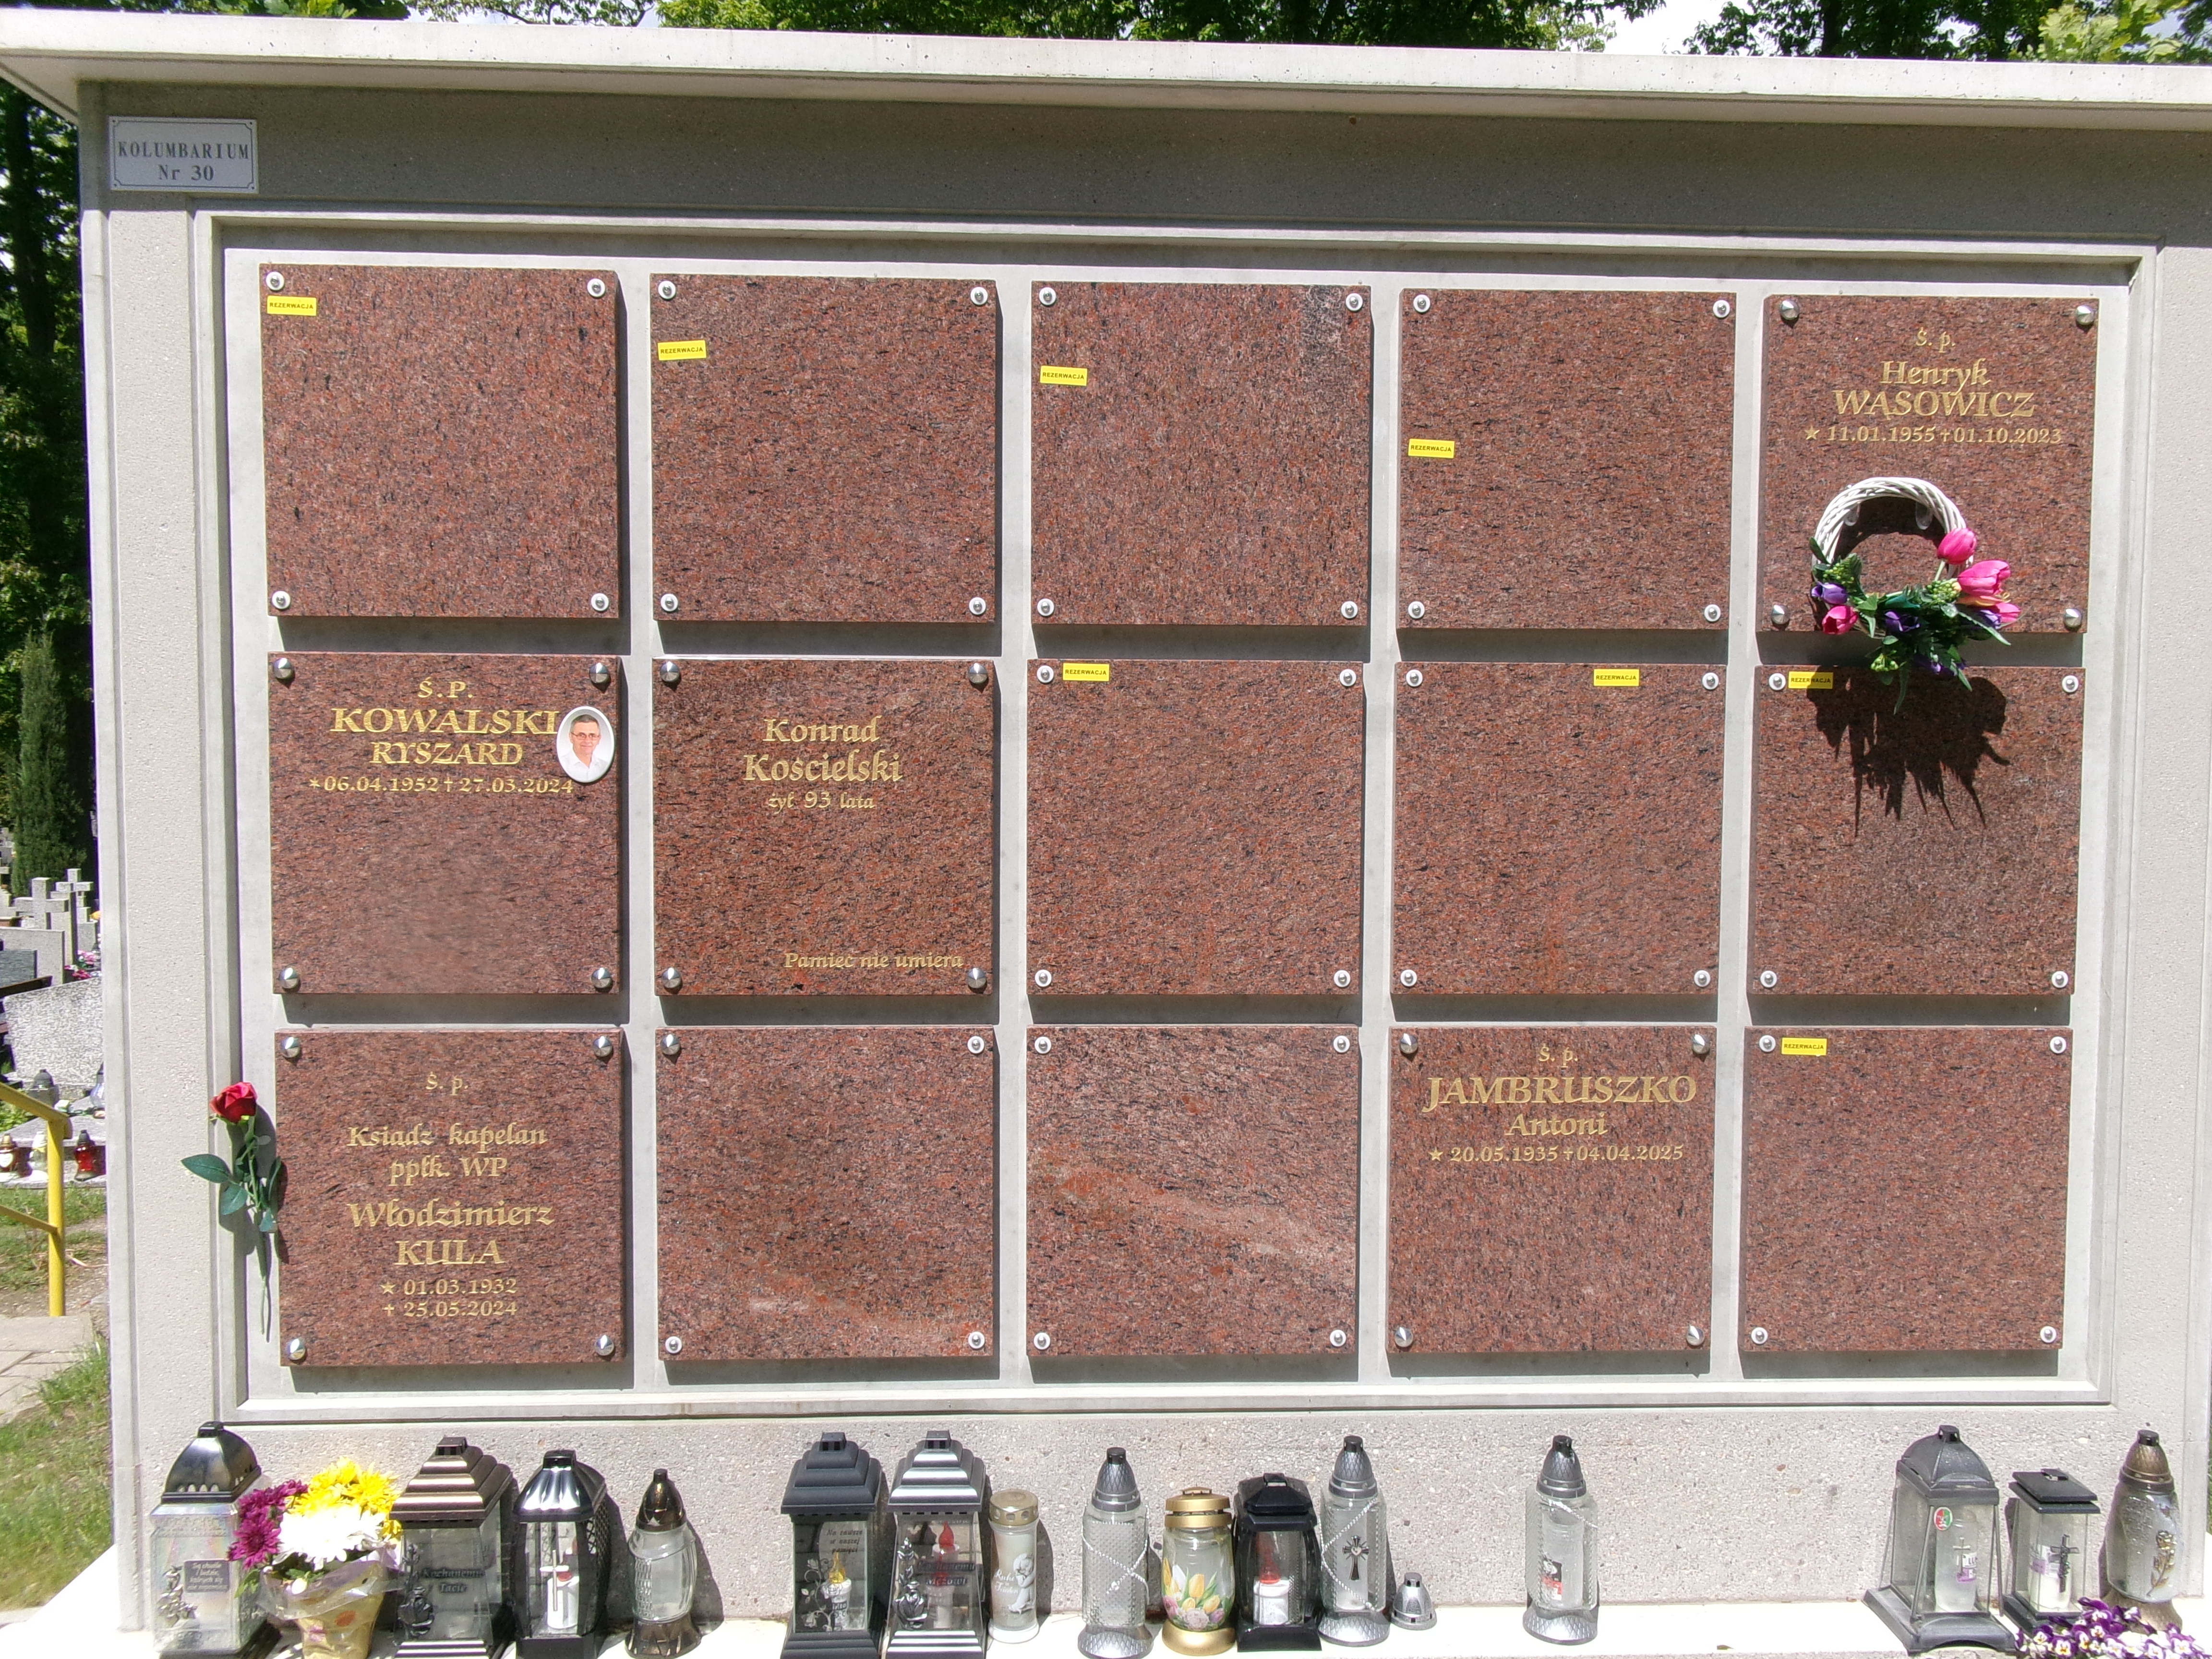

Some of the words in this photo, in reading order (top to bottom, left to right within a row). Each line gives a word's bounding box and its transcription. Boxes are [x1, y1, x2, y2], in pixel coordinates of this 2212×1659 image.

[118, 141, 249, 159] KOLUMBARIUM
[158, 165, 180, 180] Nr
[191, 165, 214, 180] 30
[1879, 358, 1991, 397] Henryk
[1832, 389, 2037, 421] WĄSOWICZ
[1827, 425, 1936, 443] 11.01.1955
[1953, 427, 2062, 444] 01.10.2023
[330, 708, 560, 735] KOWALSKI
[762, 715, 882, 743] Konrad
[369, 741, 524, 765] RYSZARD
[743, 749, 903, 781] Kościelski
[324, 775, 442, 793] 06.04.1952
[458, 777, 574, 794] 27.03.2024
[804, 791, 831, 808] 93
[841, 792, 876, 808] lata
[784, 952, 855, 969] Pamięć
[859, 952, 890, 967] nie
[895, 951, 964, 968] umiera
[1421, 1075, 1697, 1113] JAMBRUSZKO
[1504, 1111, 1609, 1136] Antoni
[347, 1123, 434, 1147] Ksiądz
[449, 1122, 548, 1154] kapelan
[1450, 1145, 1558, 1162] 20.05.1935
[1576, 1144, 1684, 1162] 04.04.2025
[388, 1155, 450, 1186] ppłk.
[459, 1157, 507, 1177] WP
[347, 1198, 555, 1227] Włodzimierz
[394, 1239, 505, 1265] KULA
[404, 1279, 518, 1295] 01.03.1932
[404, 1301, 517, 1317] 25.05.2024
